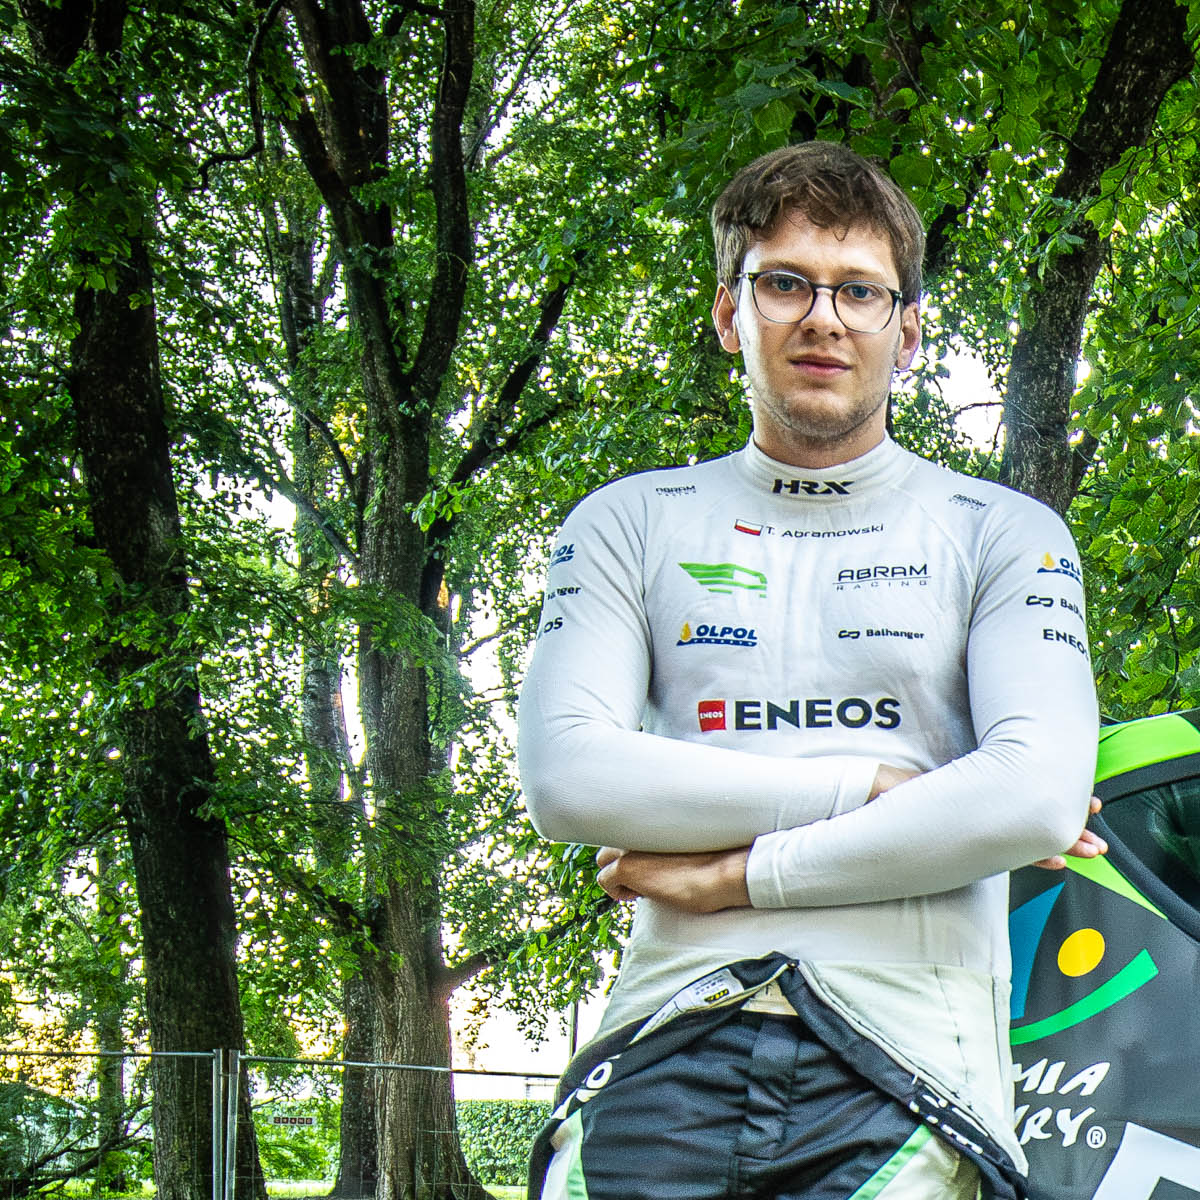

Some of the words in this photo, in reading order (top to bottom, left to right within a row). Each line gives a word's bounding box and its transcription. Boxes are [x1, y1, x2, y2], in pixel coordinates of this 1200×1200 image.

[772, 479, 855, 495] HRX
[781, 523, 884, 539] Abramowski
[838, 563, 928, 582] ABRAM
[696, 624, 757, 640] OLPOL
[866, 628, 925, 640] Balhanger
[1043, 629, 1089, 661] ENEO
[735, 698, 901, 730] ENEOS
